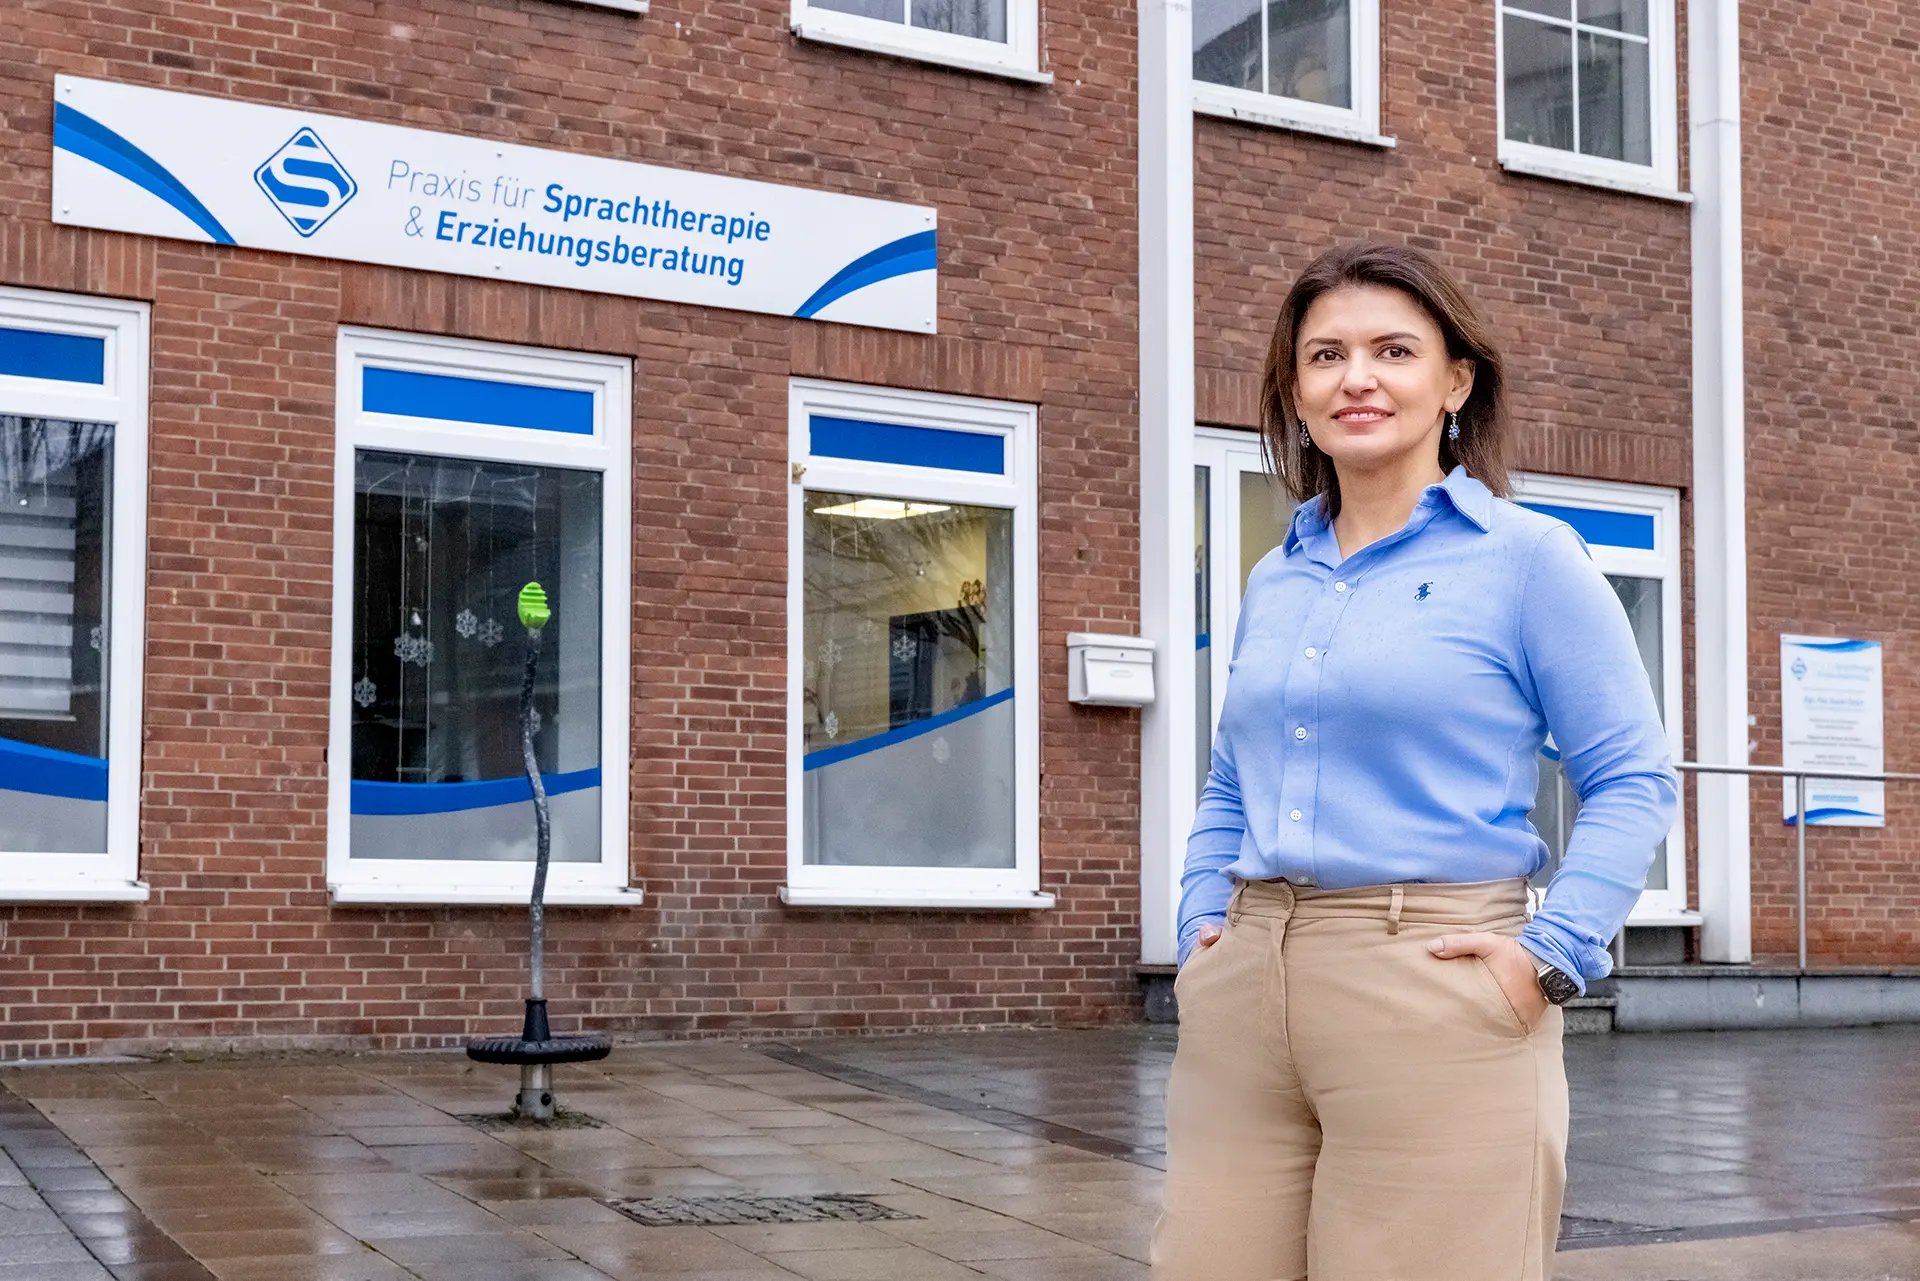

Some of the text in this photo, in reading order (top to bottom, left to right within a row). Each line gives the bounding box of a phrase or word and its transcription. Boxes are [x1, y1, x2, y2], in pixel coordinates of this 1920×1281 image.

[388, 159, 771, 244] Praxis für Sprachtherapie
[404, 206, 744, 286] & Erziehungsberatung
